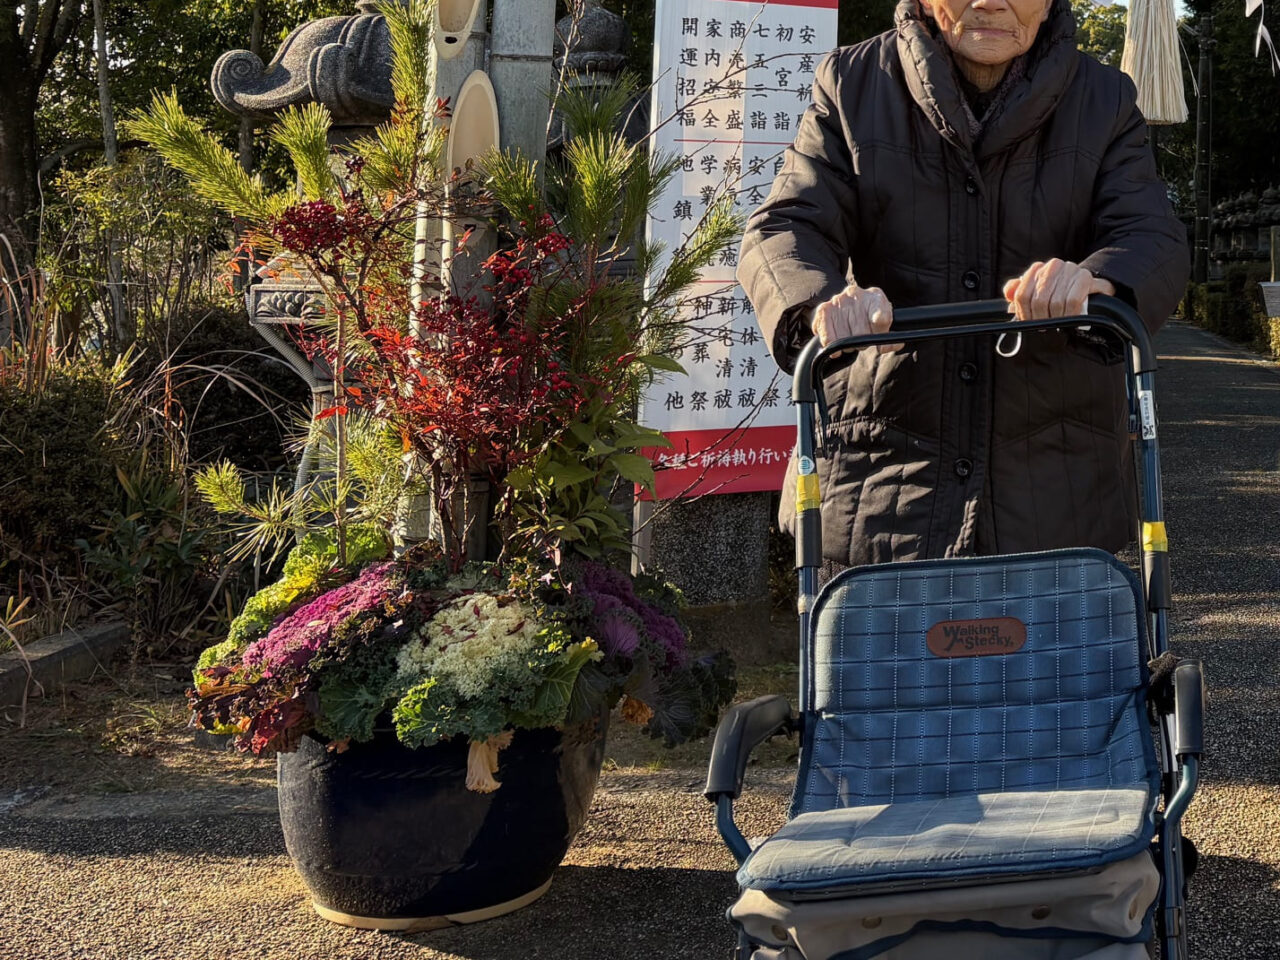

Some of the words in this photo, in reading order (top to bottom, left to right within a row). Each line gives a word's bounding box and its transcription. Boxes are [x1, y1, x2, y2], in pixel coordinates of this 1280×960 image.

[679, 17, 699, 127] 開運招福
[701, 19, 722, 128] 家内安全
[725, 21, 746, 130] 商売繁盛
[750, 23, 770, 130] 七五三詣
[773, 23, 793, 131] 初宮詣
[796, 25, 815, 129] 安産祈
[943, 624, 999, 639] Walking
